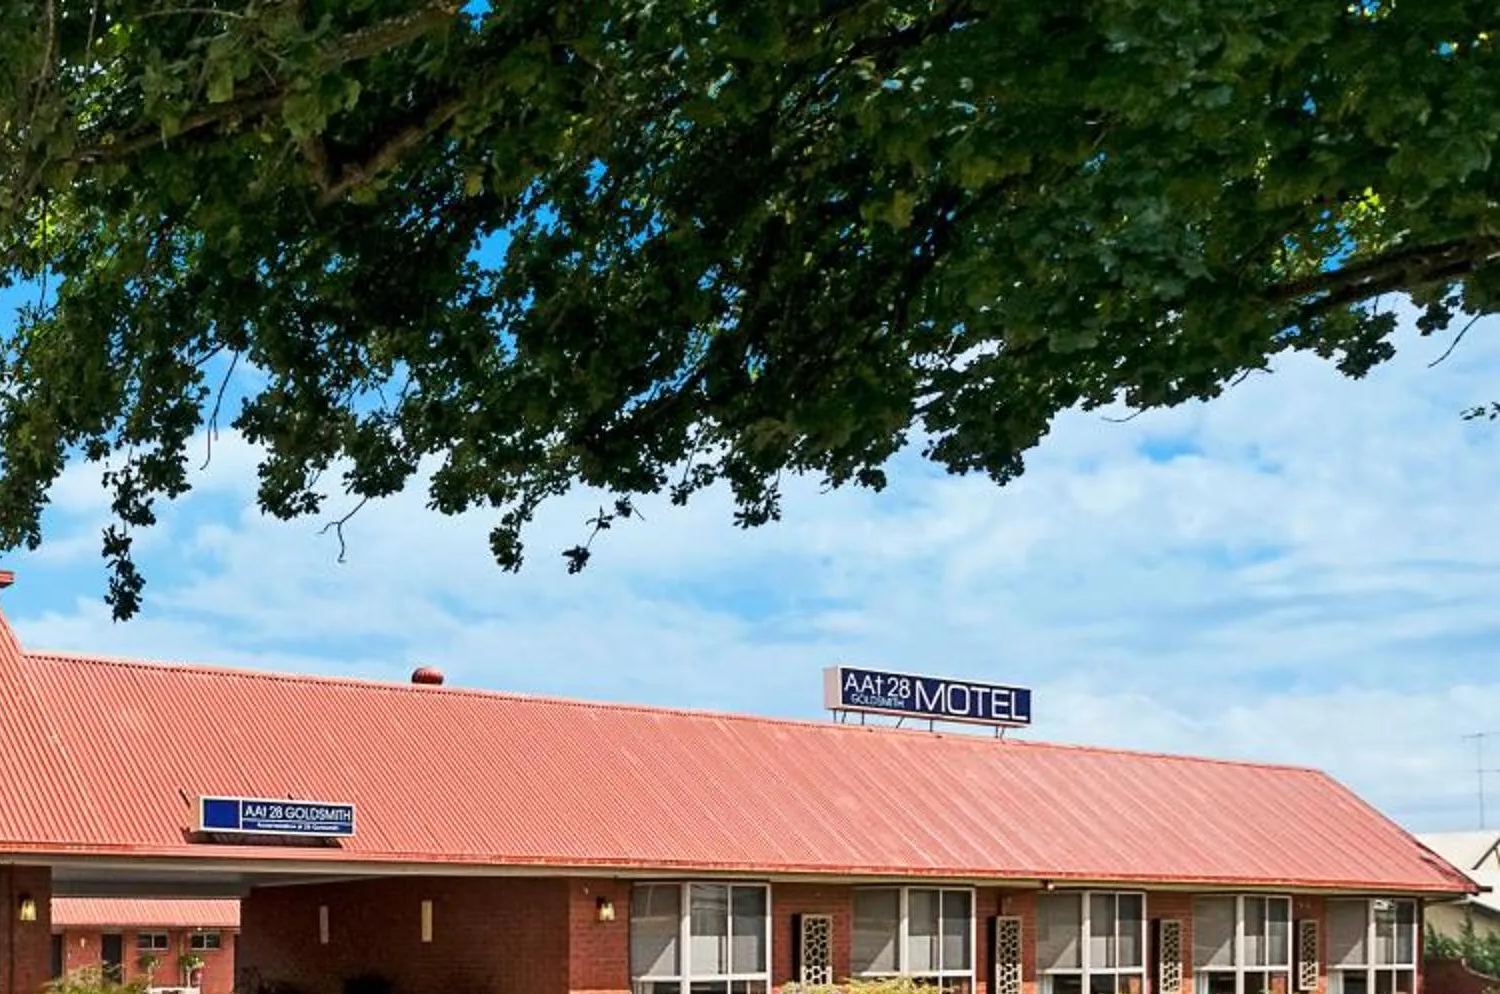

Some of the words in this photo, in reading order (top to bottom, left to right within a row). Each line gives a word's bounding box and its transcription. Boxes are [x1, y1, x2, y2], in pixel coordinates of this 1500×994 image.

[851, 693, 904, 709] GOLDSMITH
[888, 677, 911, 699] 28
[915, 680, 1028, 721] MOTEL
[269, 806, 283, 819] 28
[285, 807, 351, 821] GOLDSMITH
